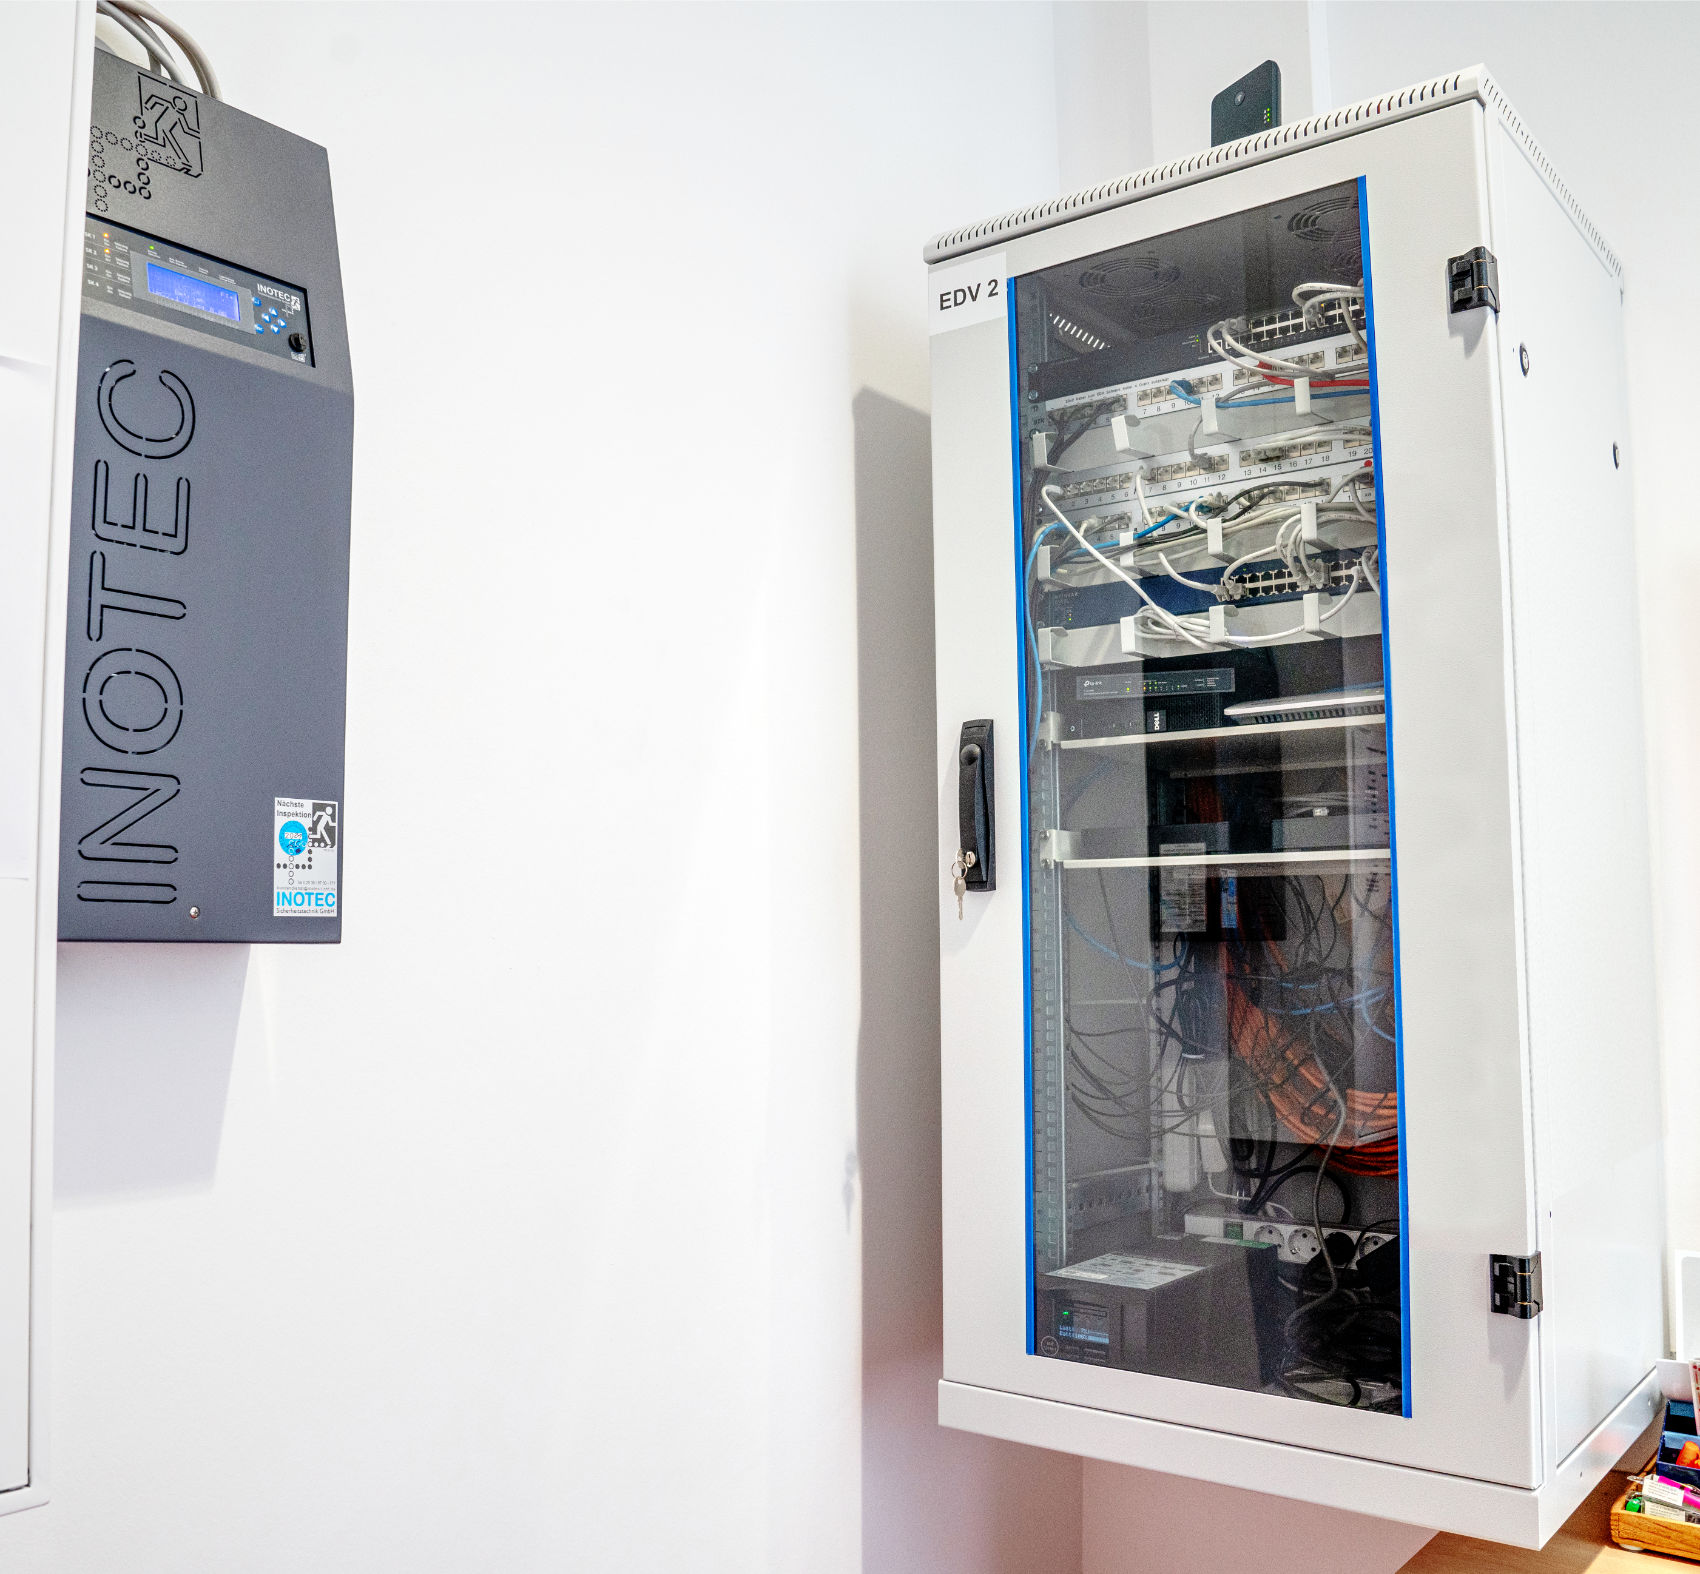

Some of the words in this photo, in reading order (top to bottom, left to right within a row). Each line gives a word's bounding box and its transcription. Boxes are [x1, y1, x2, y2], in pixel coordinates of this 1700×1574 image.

[257, 283, 291, 302] INOTEC
[940, 283, 981, 311] EDV
[987, 279, 999, 298] 2
[1348, 450, 1357, 458] 19
[1363, 447, 1373, 455] 20
[76, 358, 196, 904] INOTEC
[276, 809, 312, 818] Inspektion
[276, 891, 336, 907] INOTEC
